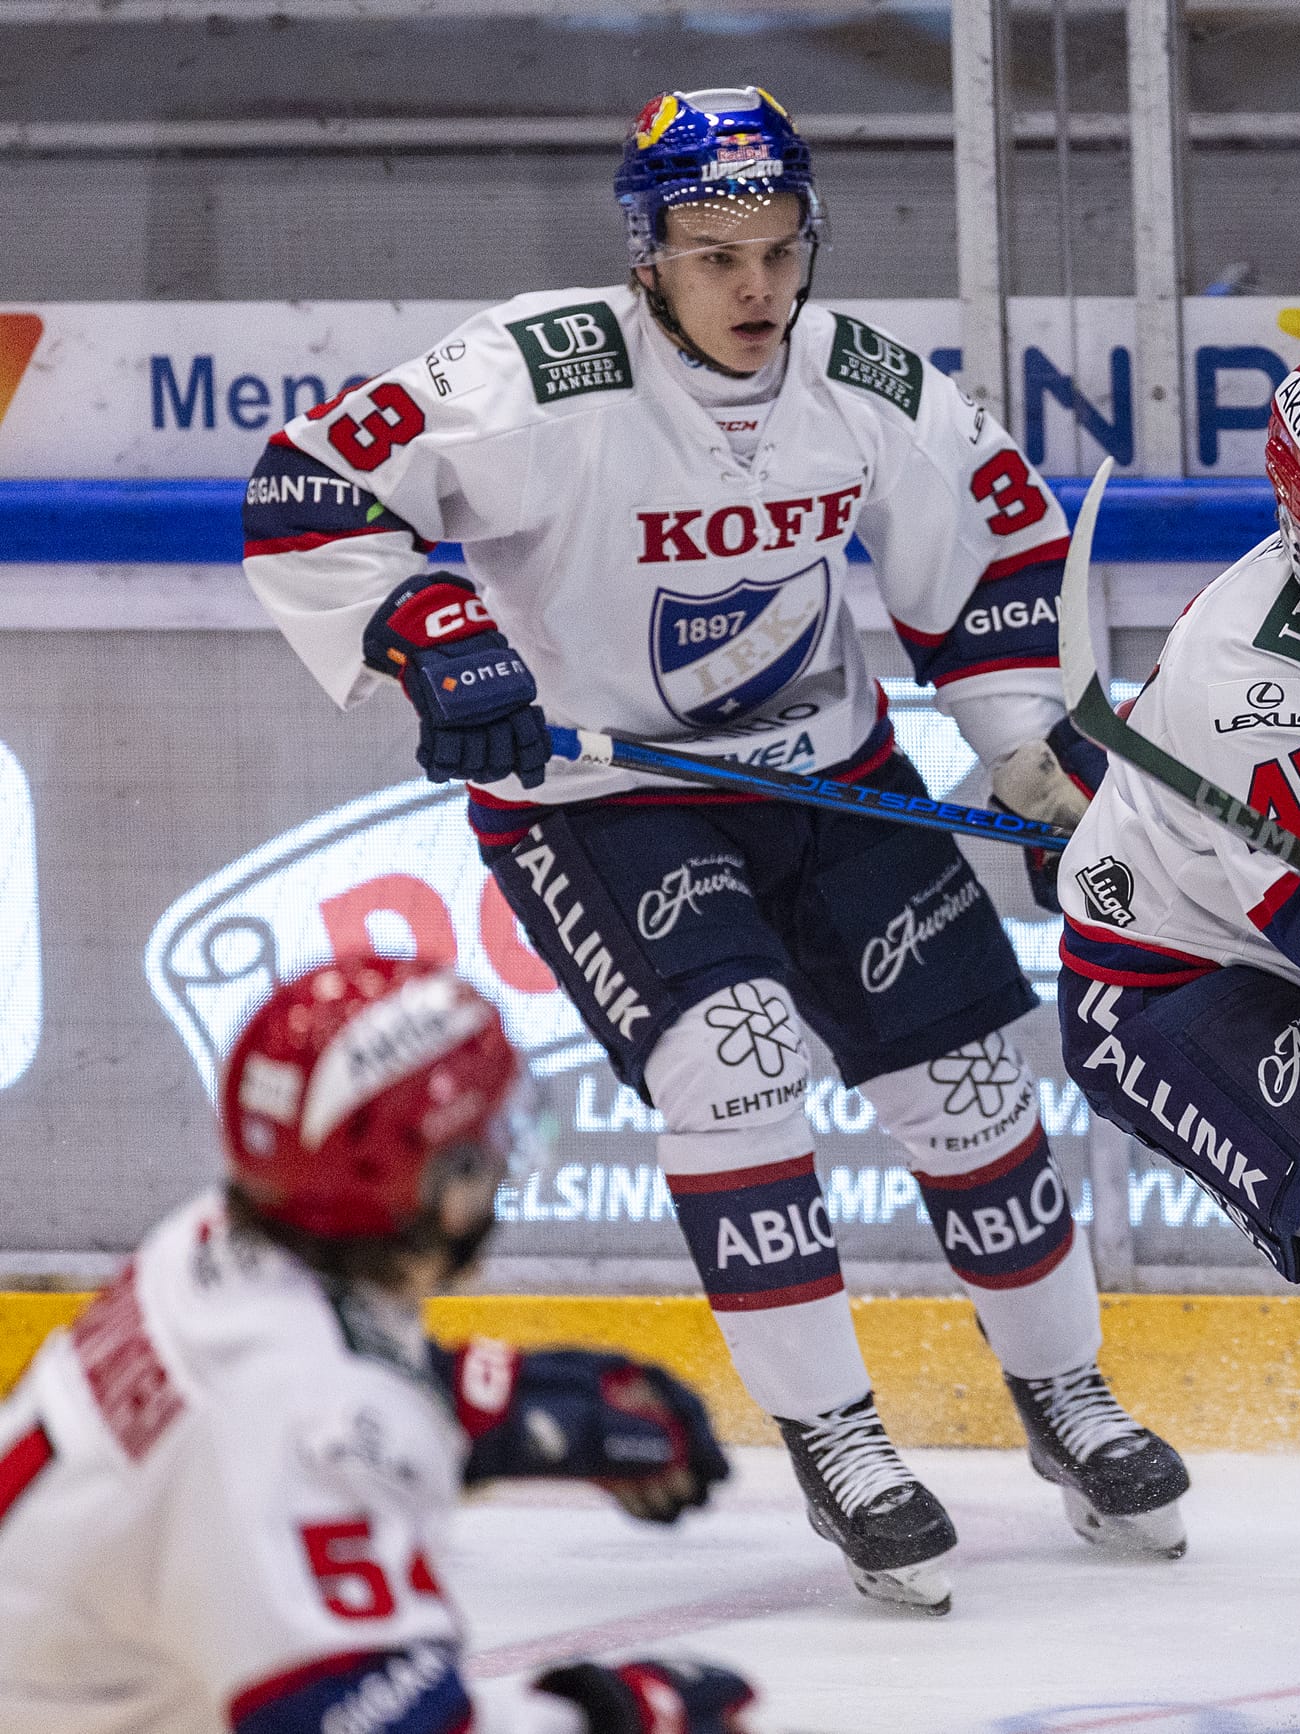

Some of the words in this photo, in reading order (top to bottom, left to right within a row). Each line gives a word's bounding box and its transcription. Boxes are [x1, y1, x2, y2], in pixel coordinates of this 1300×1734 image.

[525, 313, 607, 358] UB
[847, 319, 910, 377] UB
[546, 369, 625, 394] BANKERS
[548, 357, 615, 380] UNITED
[149, 353, 368, 431] Men
[636, 483, 862, 565] KOFF
[674, 609, 748, 648] 1897
[459, 659, 528, 686] OMEN
[790, 775, 1025, 833] JETSPEED
